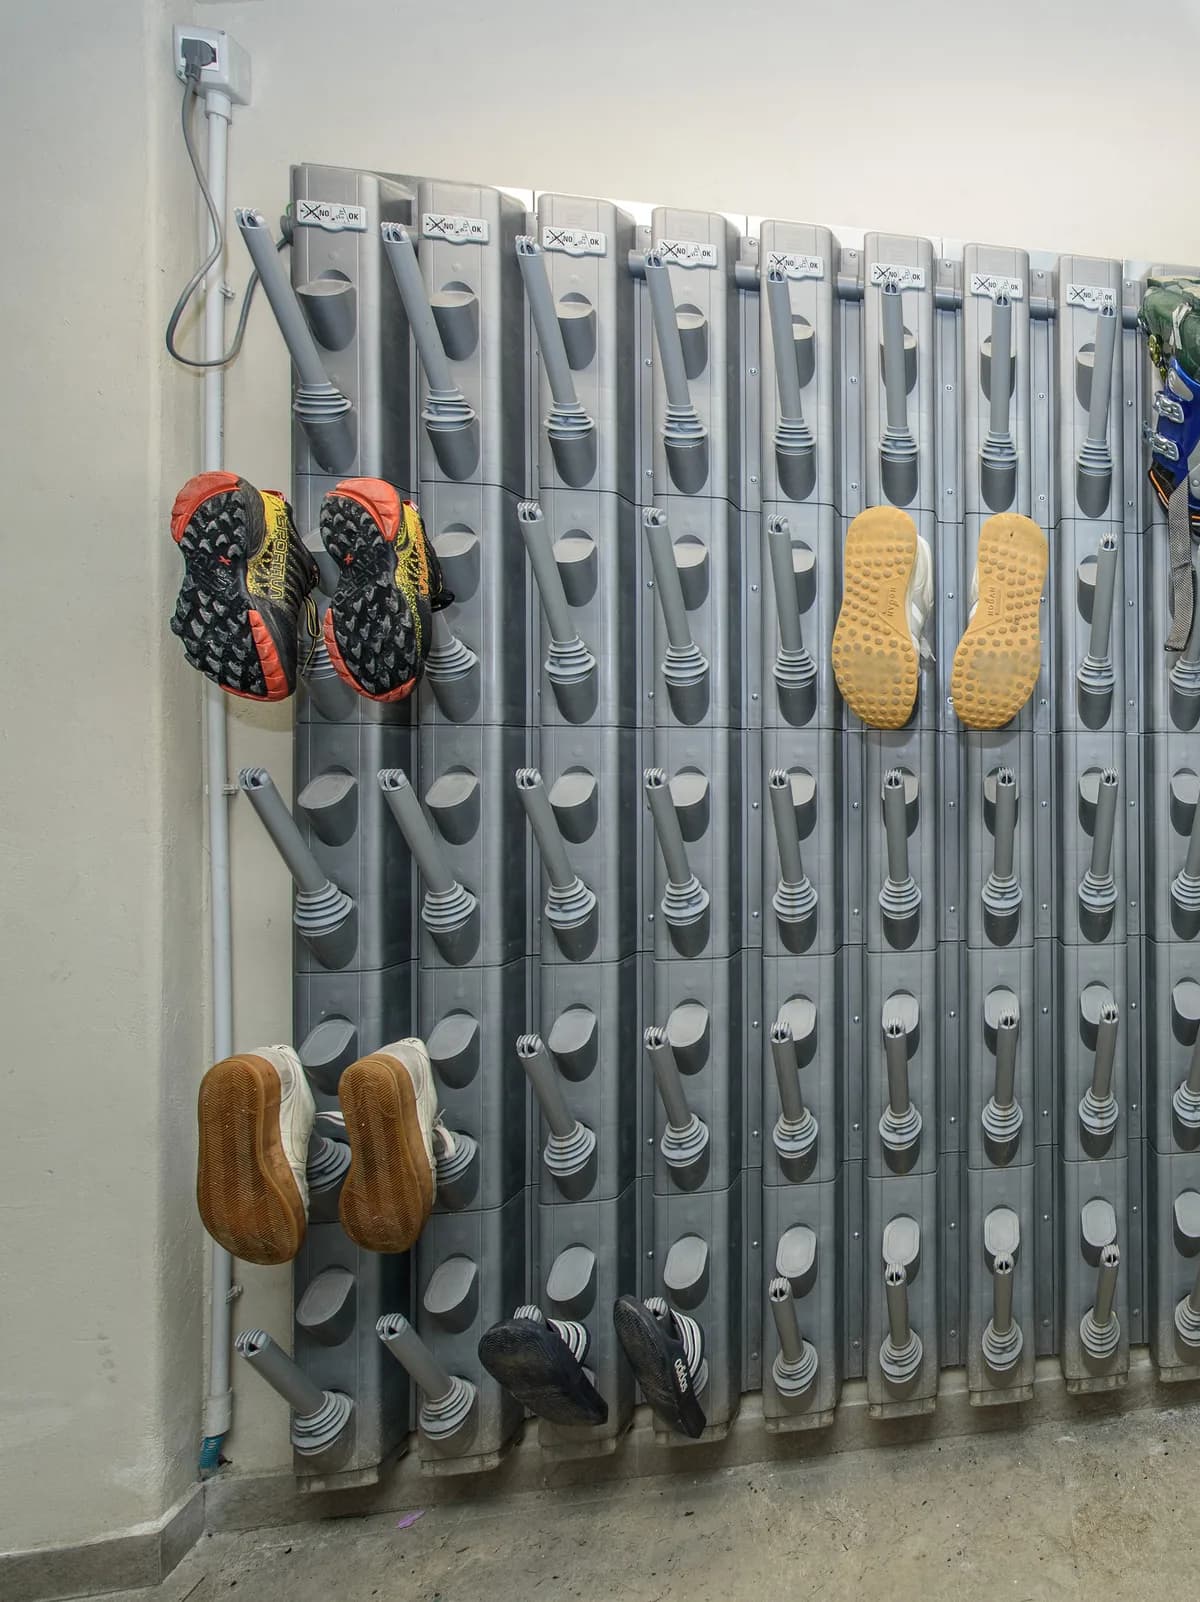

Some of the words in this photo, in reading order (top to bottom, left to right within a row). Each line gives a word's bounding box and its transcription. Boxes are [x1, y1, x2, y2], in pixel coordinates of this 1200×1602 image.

[319, 209, 330, 217] NO
[348, 212, 359, 220] OK
[444, 222, 454, 230] NO
[471, 225, 482, 233] OK
[562, 235, 573, 243] NO
[589, 238, 600, 246] OK
[676, 247, 686, 255] NO
[702, 249, 711, 257] OK
[785, 259, 795, 267] NO
[271, 514, 288, 599] SPORTIVA
[674, 1358, 688, 1393] adidas
